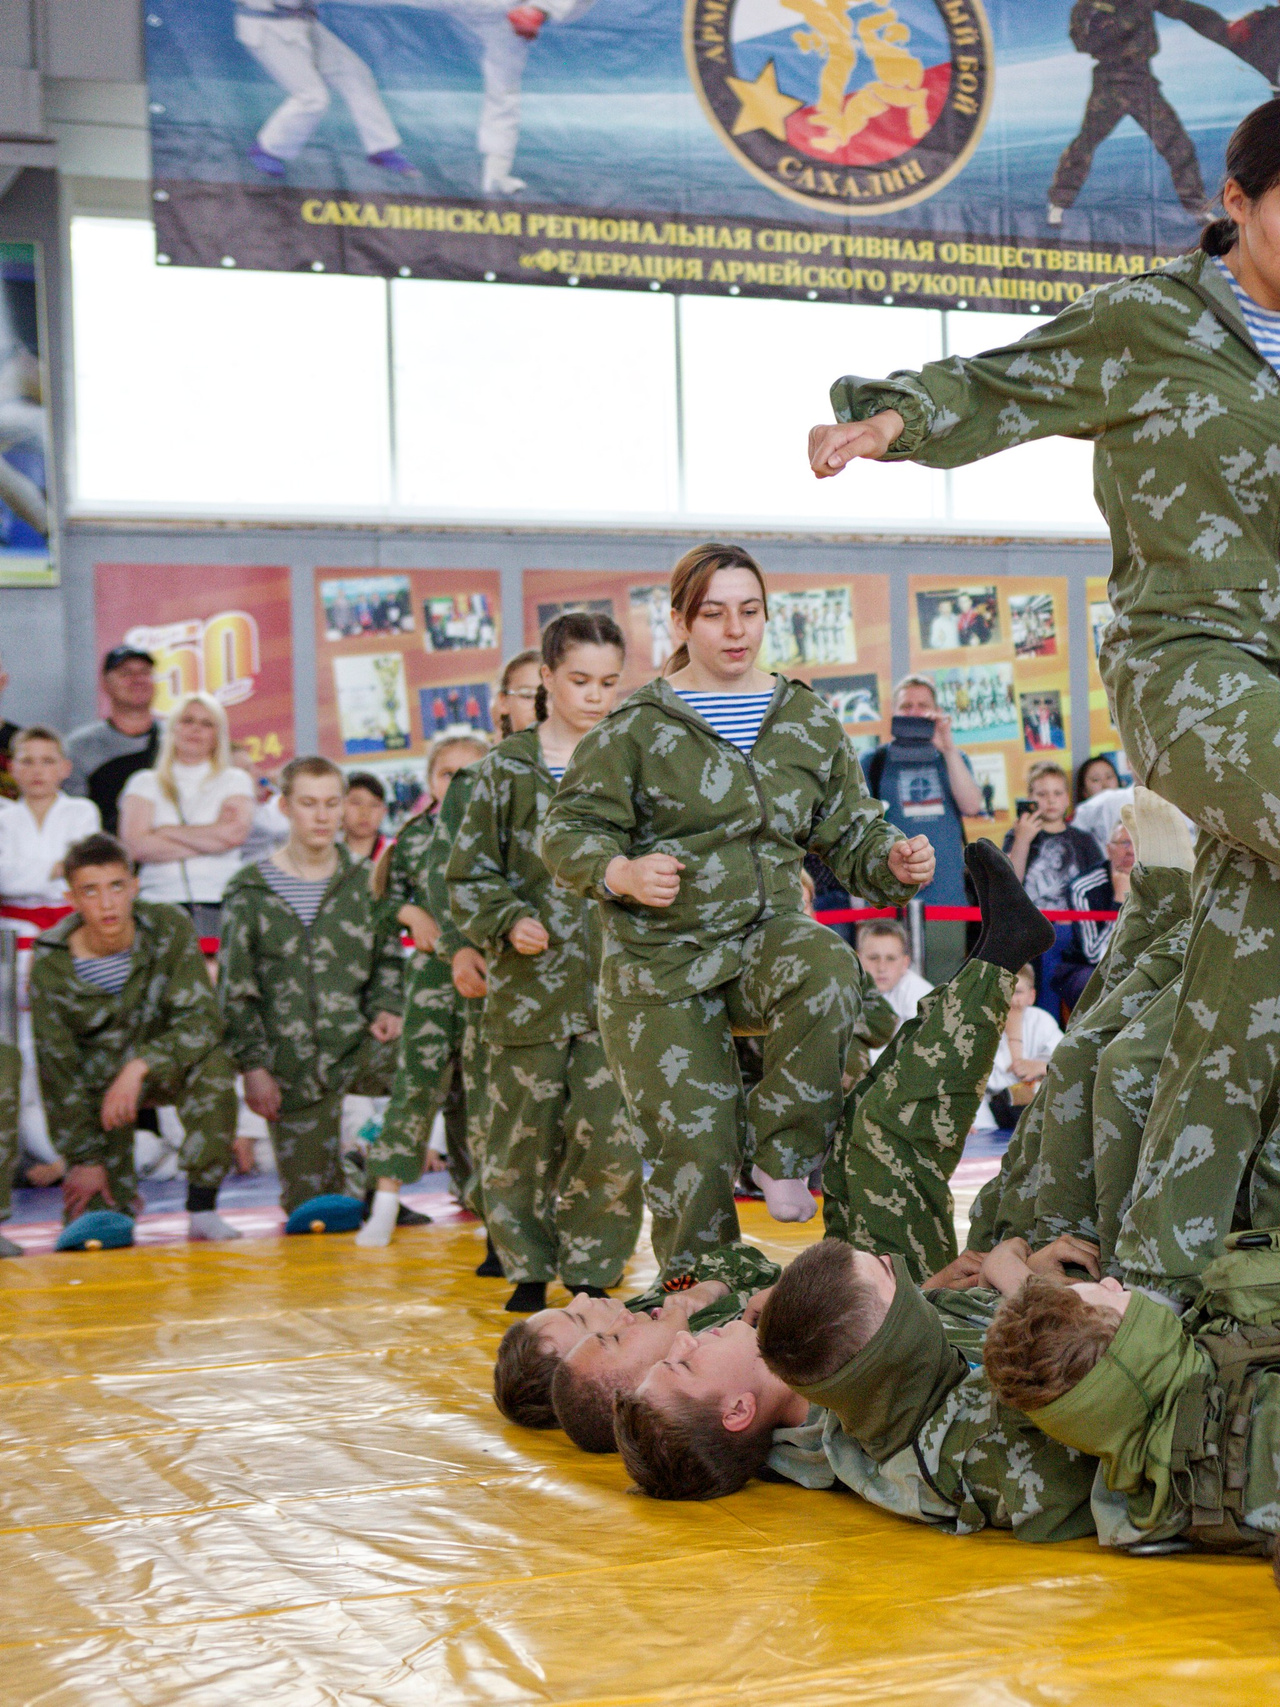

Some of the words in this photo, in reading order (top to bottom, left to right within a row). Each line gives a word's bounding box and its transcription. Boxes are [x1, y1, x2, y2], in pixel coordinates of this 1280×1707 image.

[954, 53, 981, 116] БОЙ
[777, 156, 927, 198] САХАЛИН
[301, 199, 522, 236] САХАЛИНСКАЯ
[527, 212, 752, 250] РЕГИОНАЛЬНАЯ
[756, 228, 936, 262] СПОРТИВНАЯ
[939, 241, 1145, 275] ОБЩЕСТВЕННАЯ
[519, 247, 703, 282] «ФЕДЕРАЦИЯ
[708, 258, 887, 293] АРМЕЙСКОГО
[890, 271, 1086, 303] РУКОПАШНОГО
